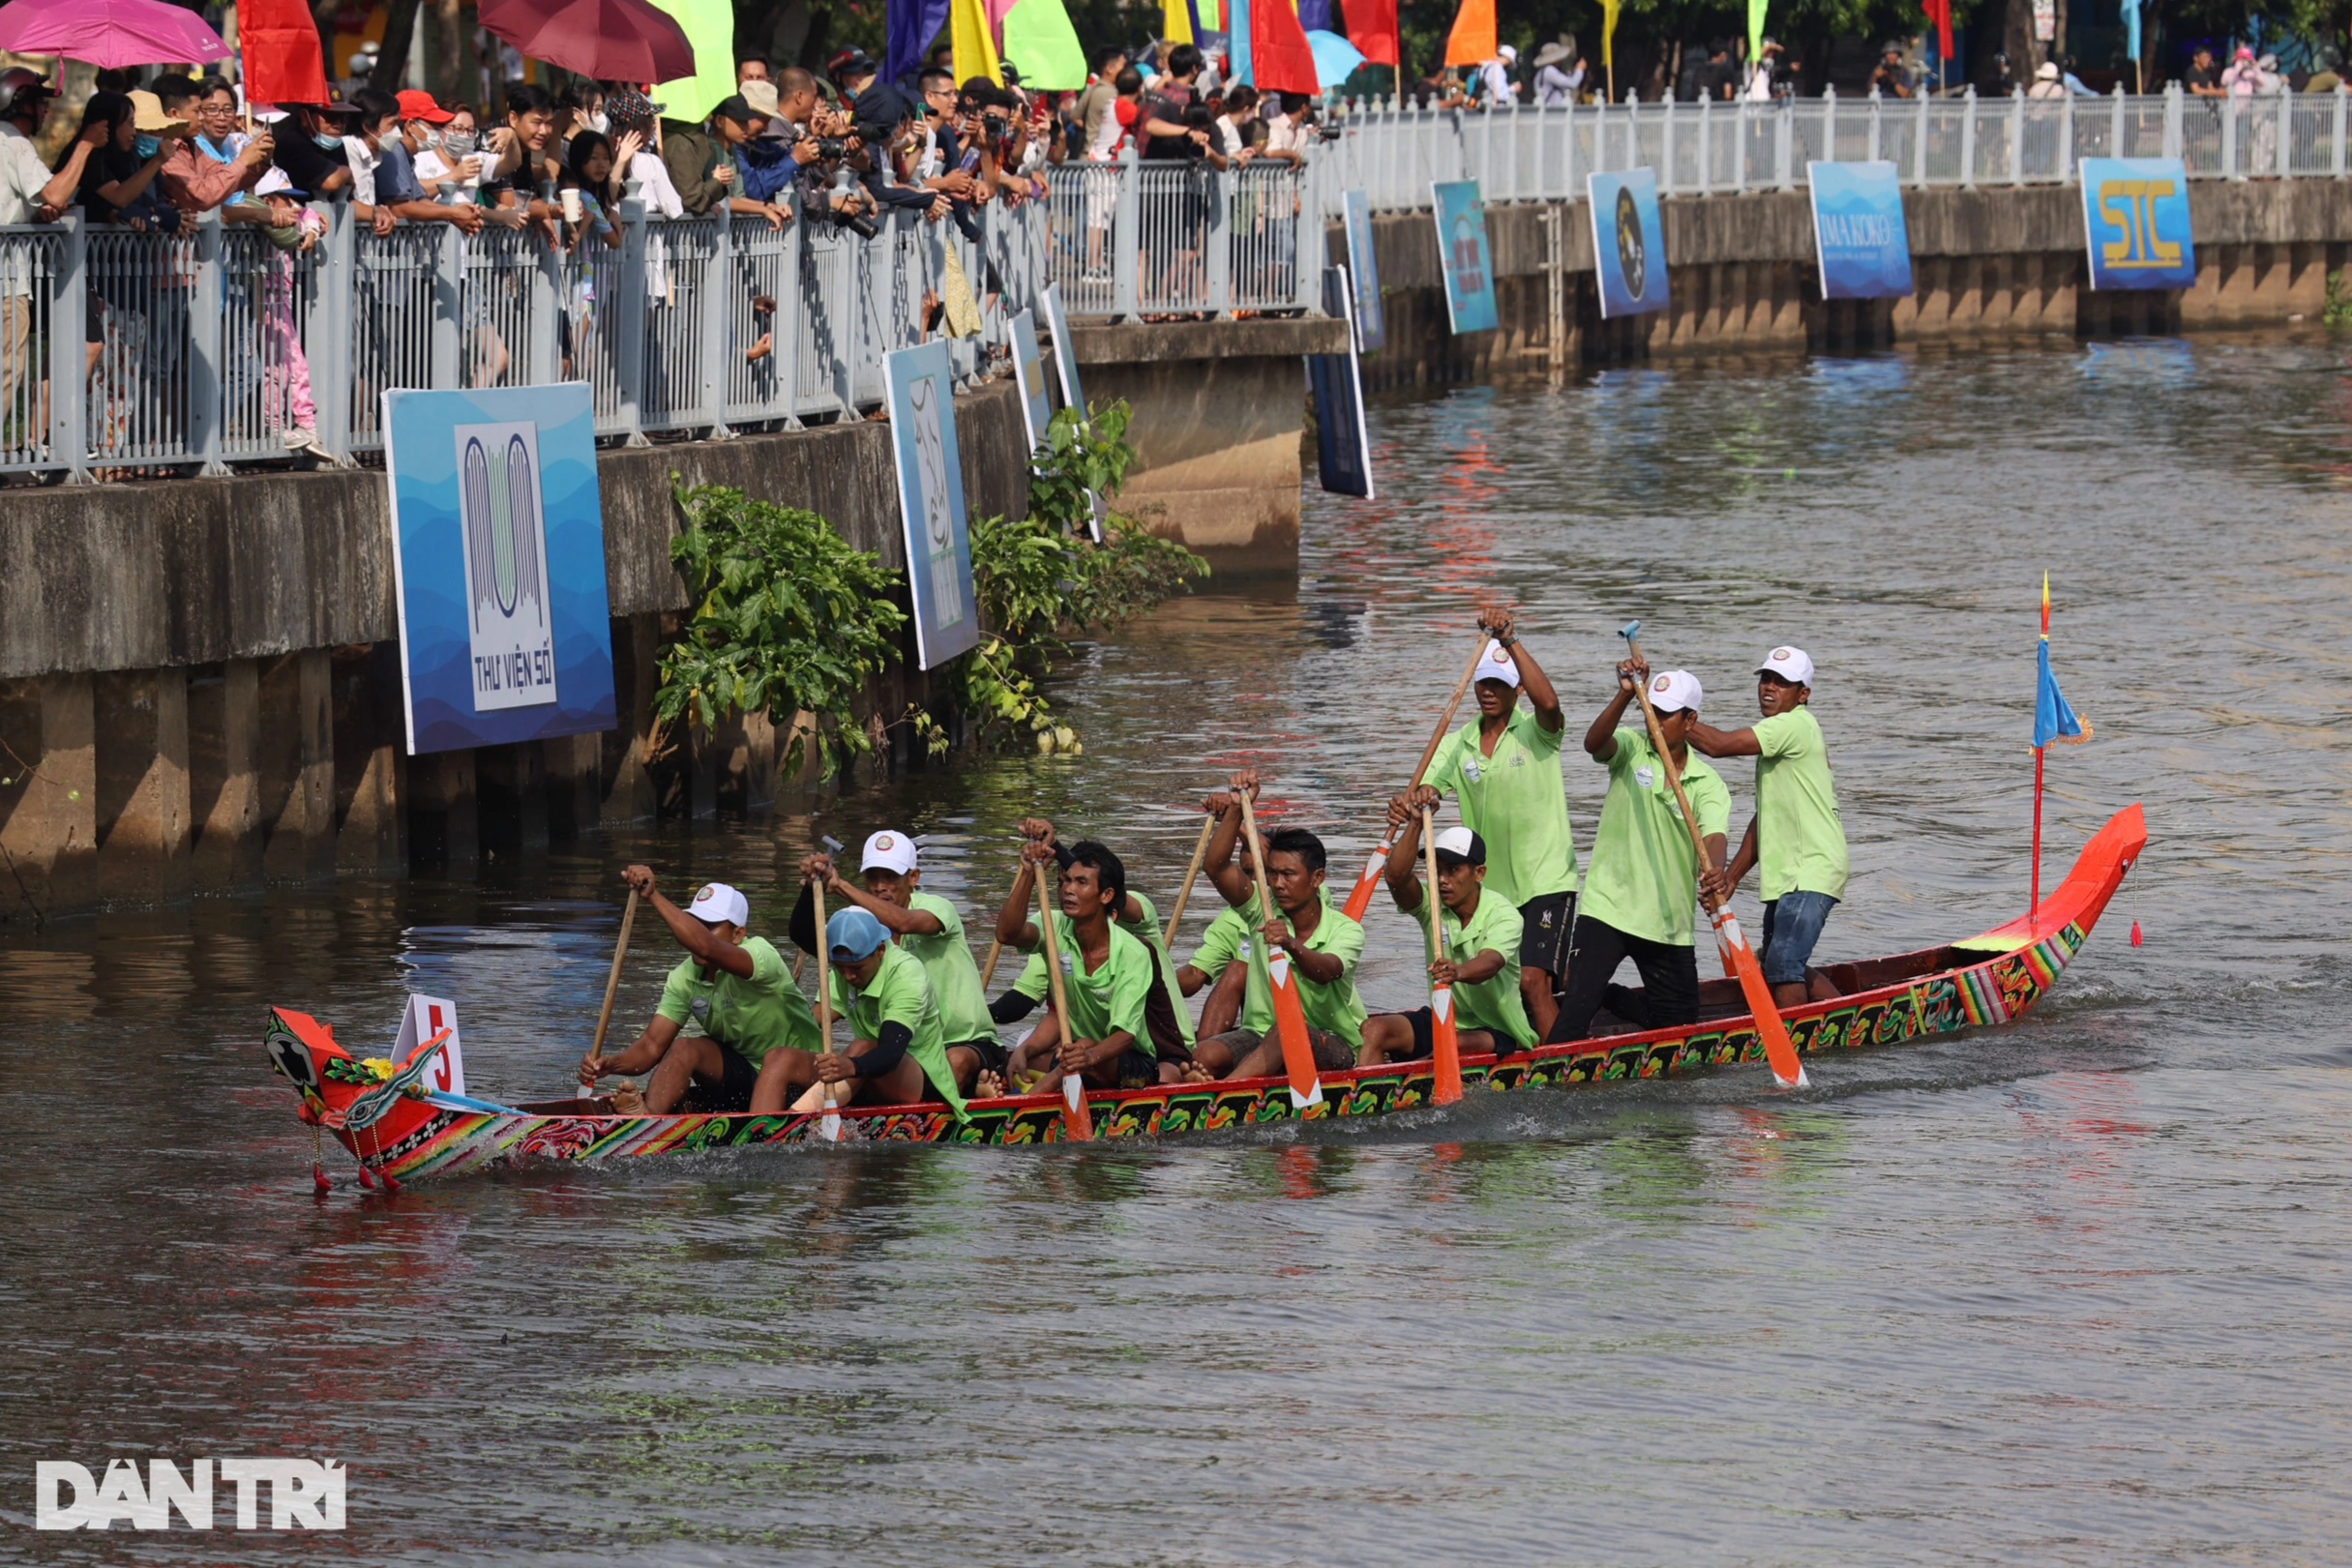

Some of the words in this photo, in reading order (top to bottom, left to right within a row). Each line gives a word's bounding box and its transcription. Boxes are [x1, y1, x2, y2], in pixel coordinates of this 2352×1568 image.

[2099, 180, 2182, 268] STC
[475, 655, 500, 692] THƯ
[503, 643, 532, 695] VIỆN
[534, 636, 551, 686] SỐ
[429, 1004, 451, 1093] 5
